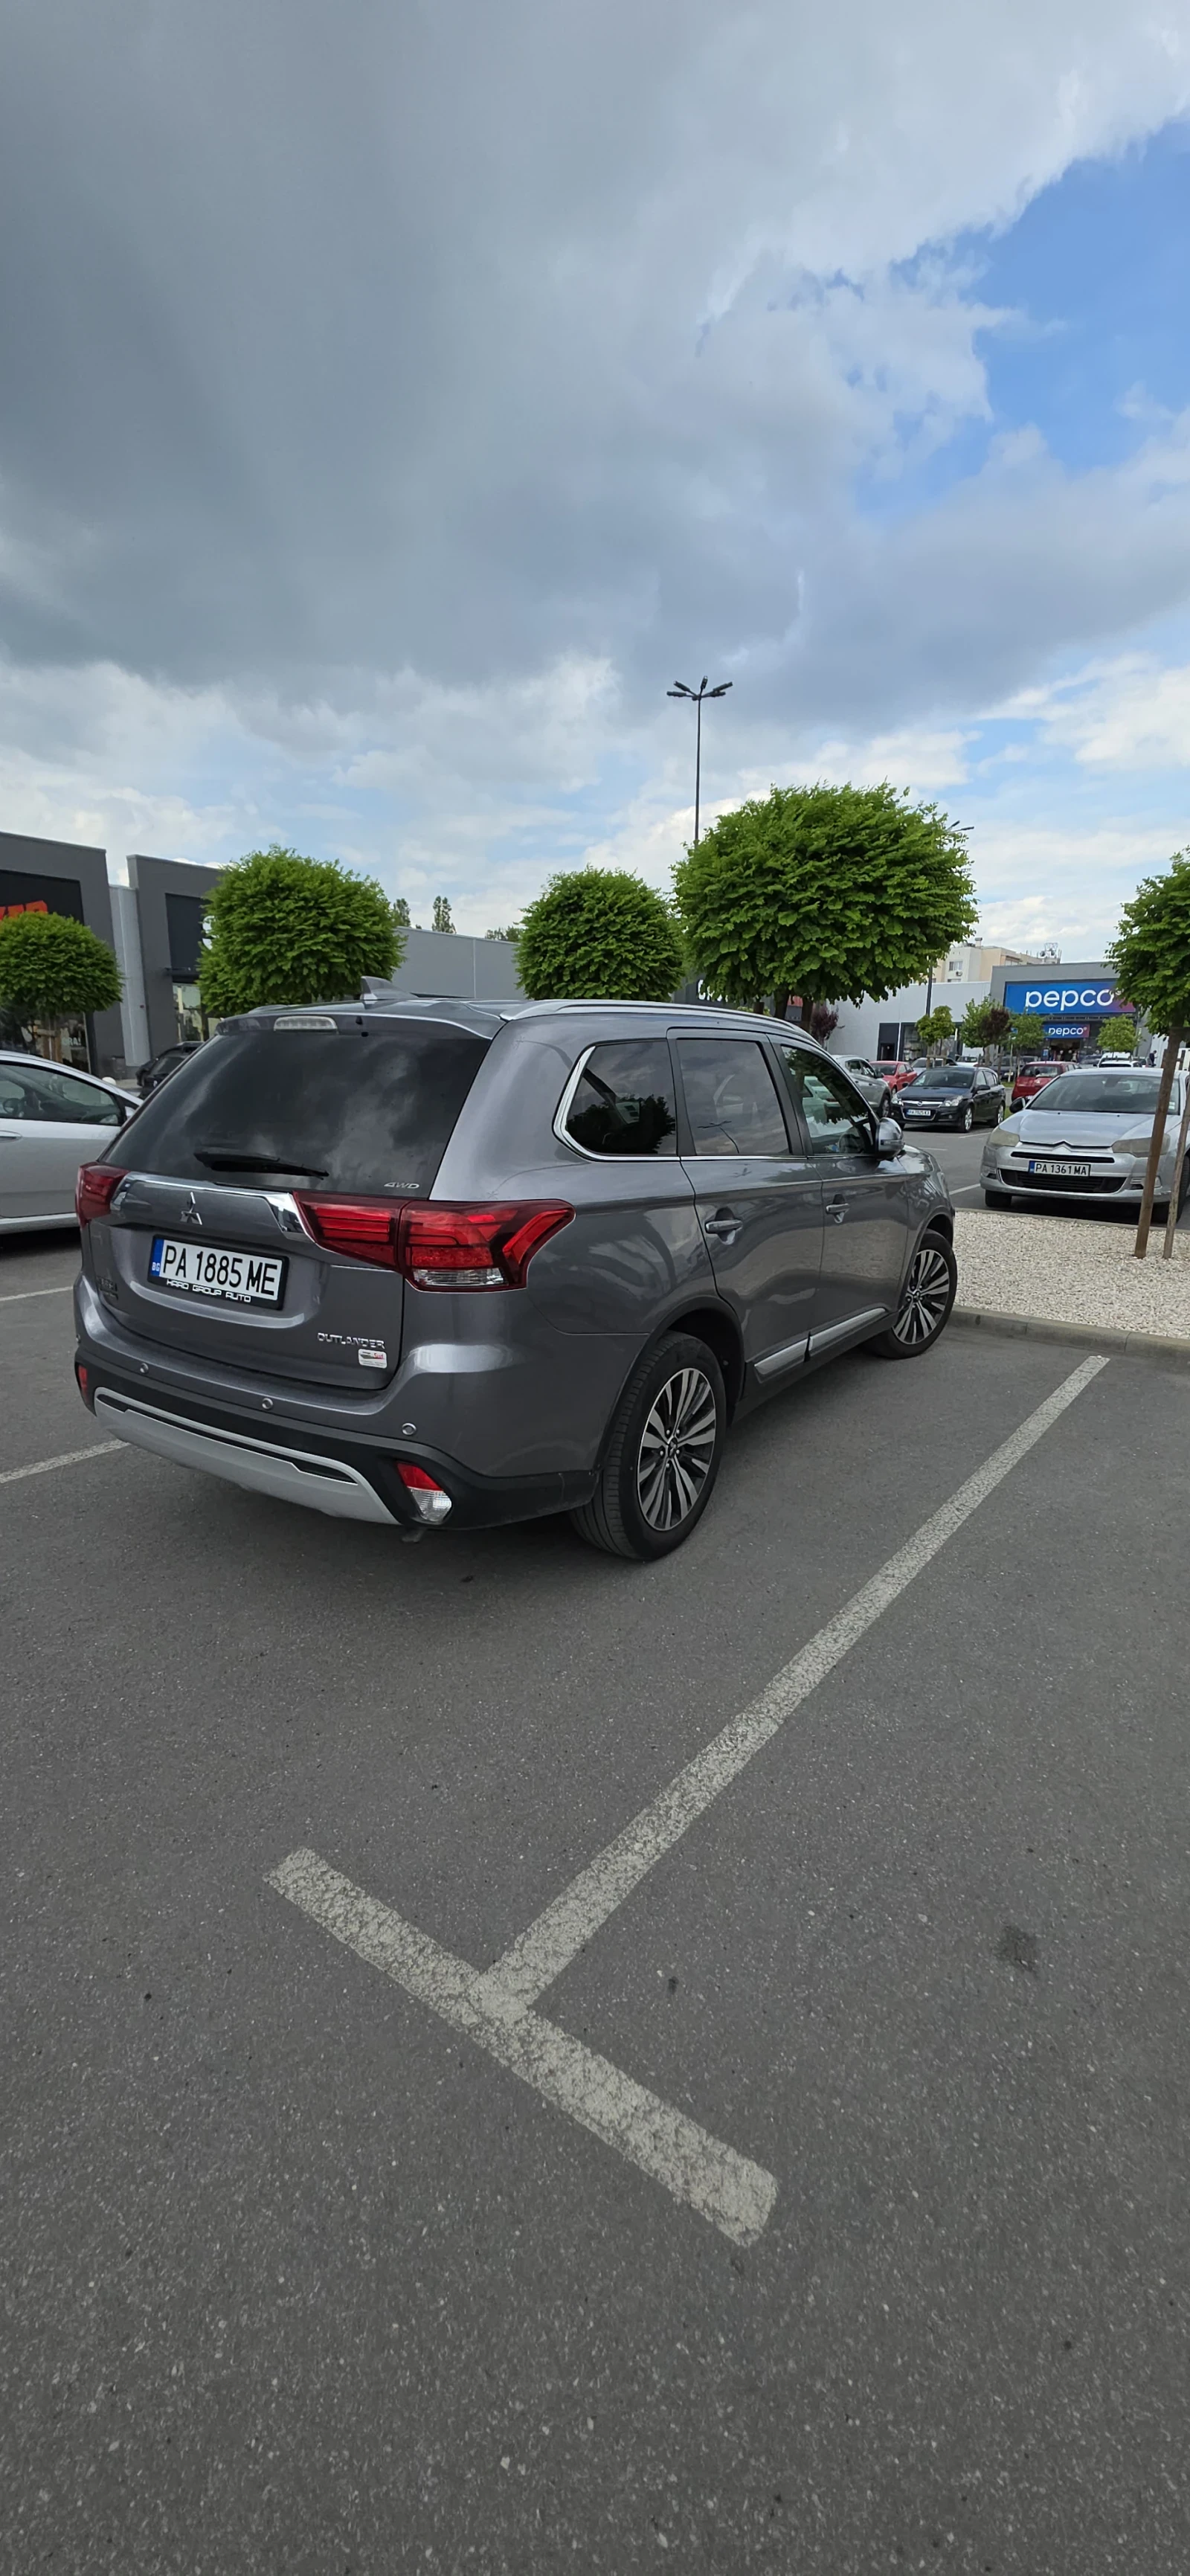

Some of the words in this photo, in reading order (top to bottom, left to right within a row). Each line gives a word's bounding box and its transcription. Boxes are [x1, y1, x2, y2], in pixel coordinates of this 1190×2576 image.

[1025, 989, 1114, 1012] pepco
[1048, 1027, 1084, 1037] pepco
[1035, 1163, 1047, 1173] PA
[1051, 1164, 1072, 1175] 1361
[1073, 1166, 1087, 1175] MA
[152, 1262, 161, 1271] BG
[163, 1244, 187, 1278] PA
[196, 1250, 243, 1288] 1885
[245, 1259, 277, 1296] ME
[192, 1285, 222, 1296] GROUP
[225, 1291, 251, 1303] AUTO
[318, 1332, 385, 1349] OUTLANDER
